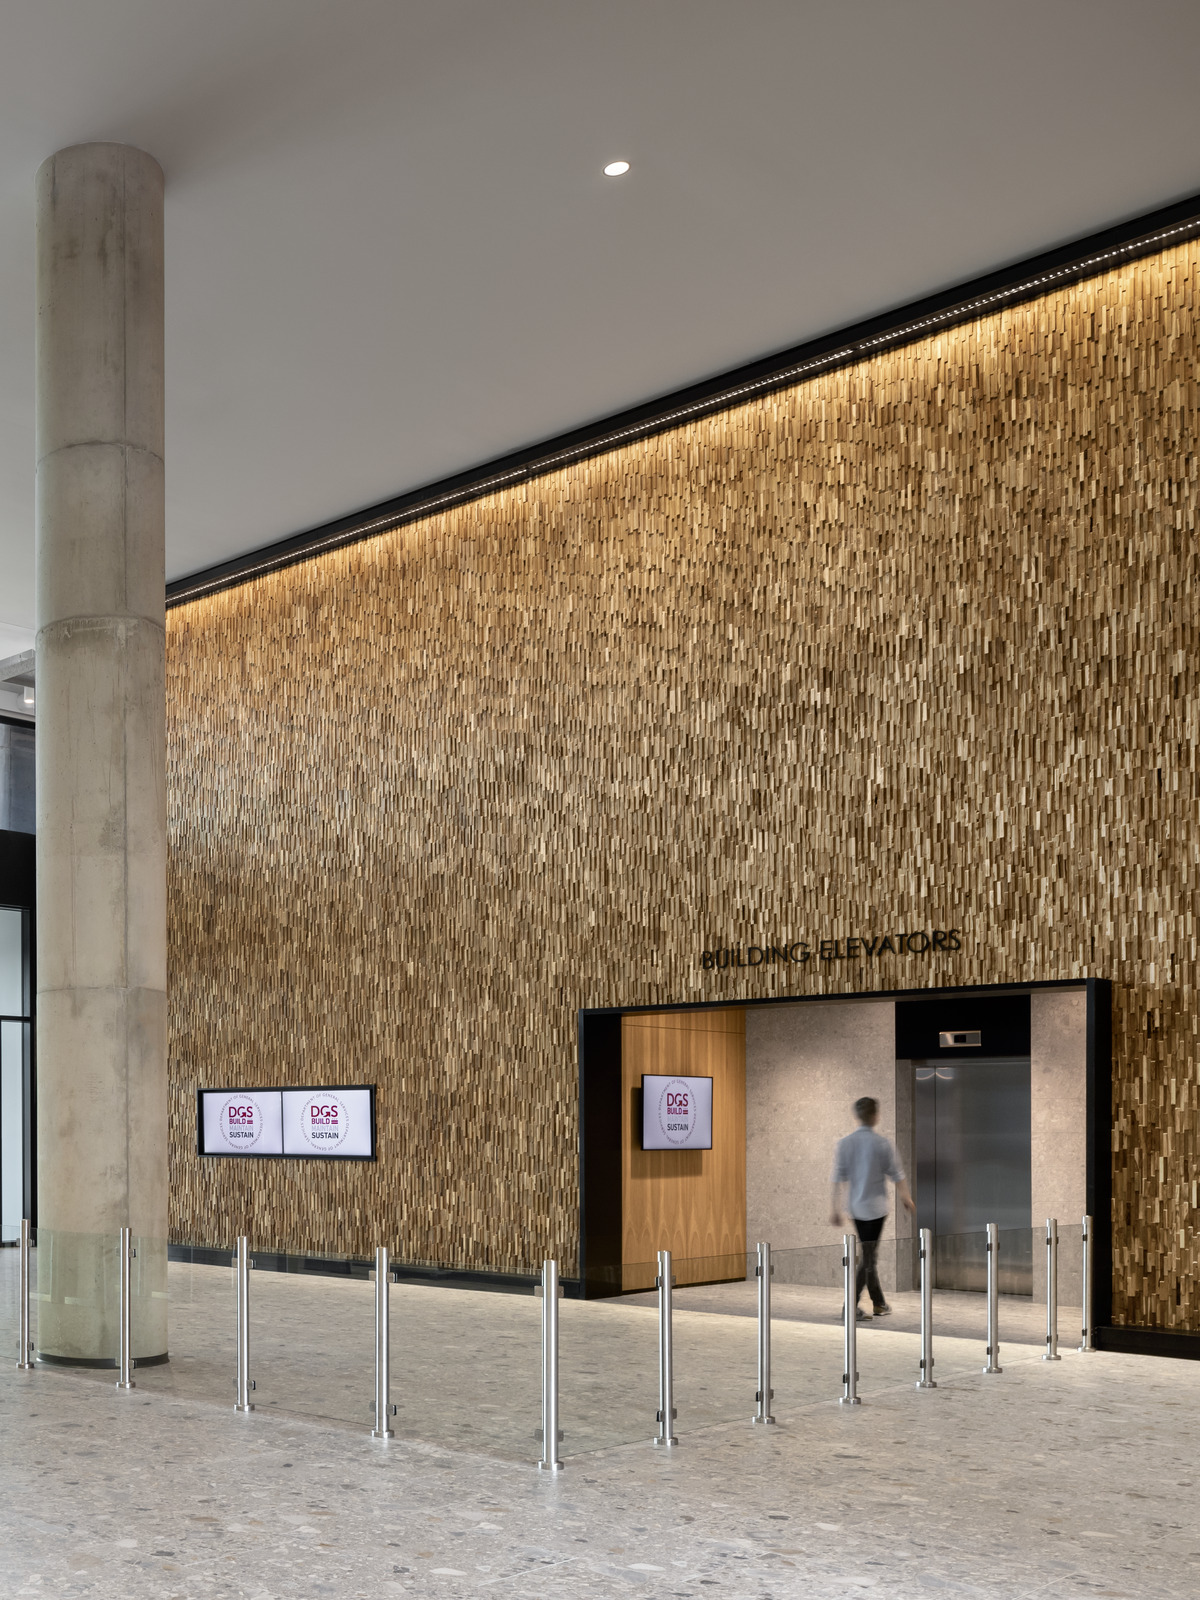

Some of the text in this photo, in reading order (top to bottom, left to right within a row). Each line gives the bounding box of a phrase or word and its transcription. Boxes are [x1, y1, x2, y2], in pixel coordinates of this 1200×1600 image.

[702, 929, 962, 970] BUILDING ELEVATORS
[667, 1093, 688, 1107] DGS
[229, 1106, 253, 1118] DGS
[311, 1105, 338, 1117] DGS
